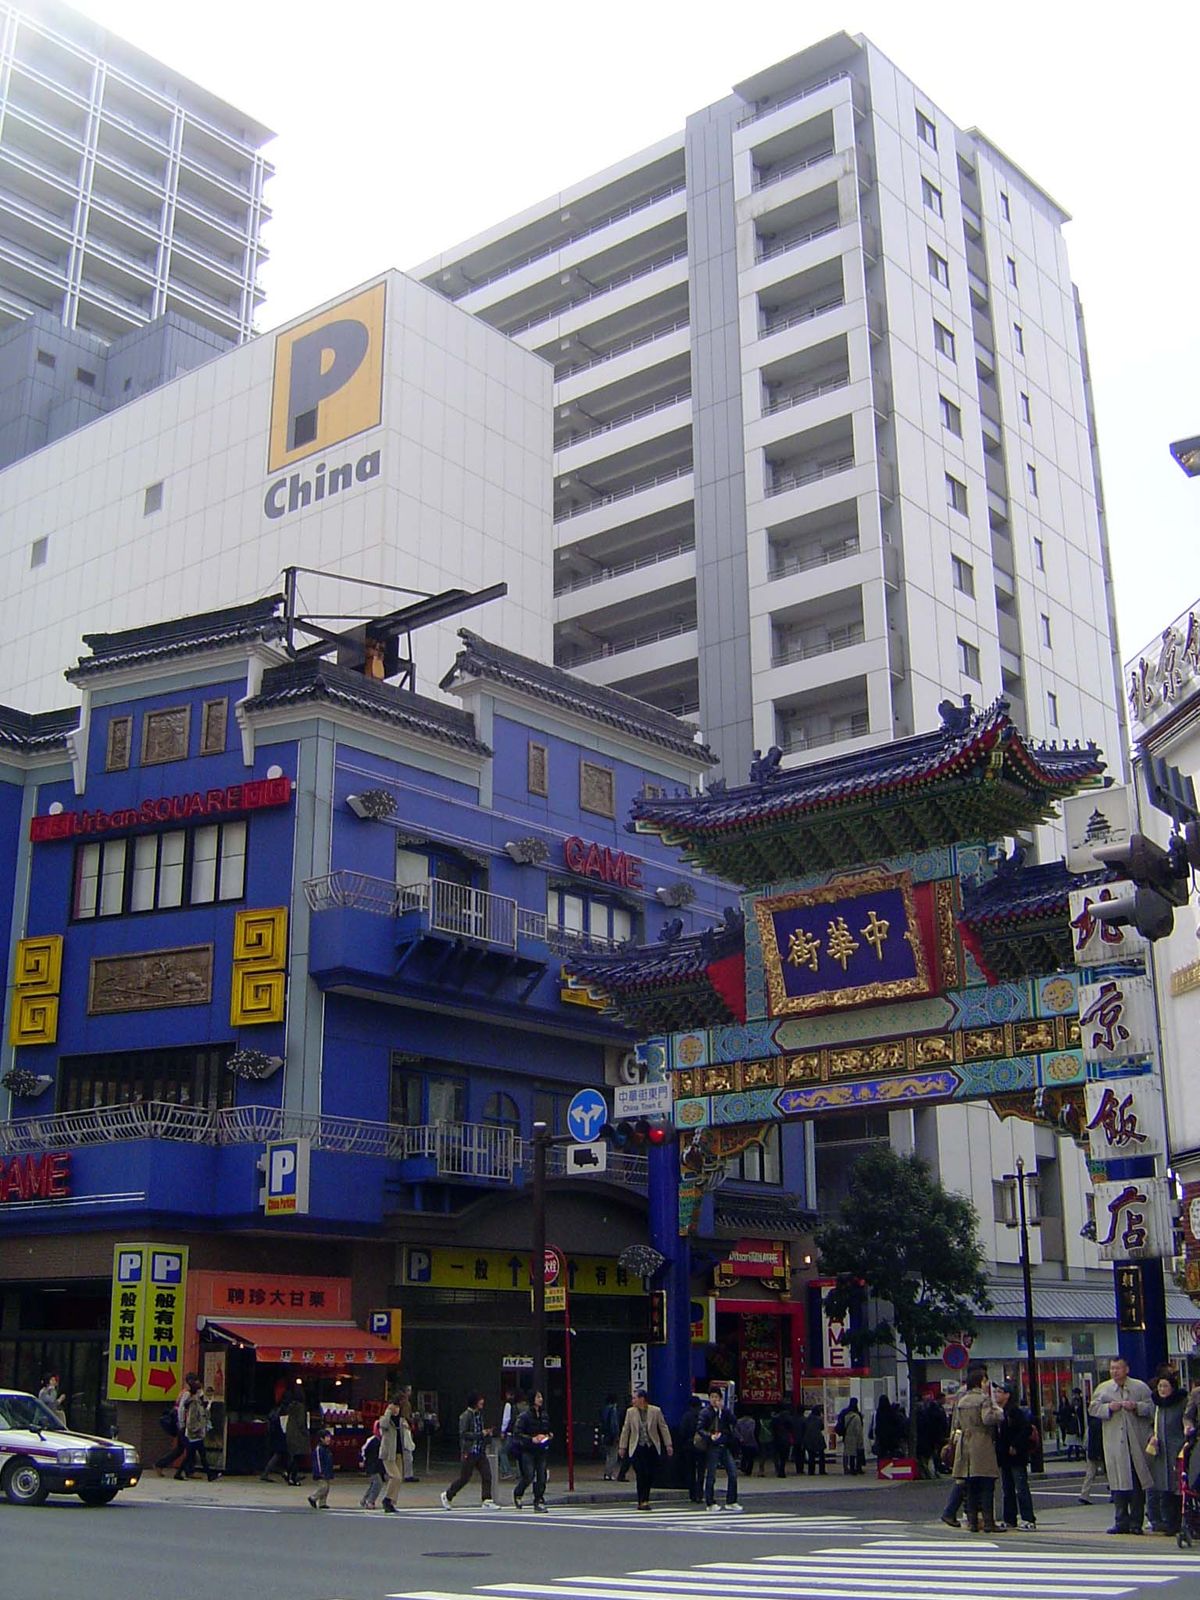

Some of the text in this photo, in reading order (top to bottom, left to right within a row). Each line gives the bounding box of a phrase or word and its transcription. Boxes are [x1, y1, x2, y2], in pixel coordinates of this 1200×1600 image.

[286, 319, 369, 453] P
[264, 450, 381, 519] China
[564, 836, 645, 890] GAME
[619, 1086, 668, 1103] 中華街東門
[623, 1104, 639, 1112] China
[0, 1151, 71, 1200] AME
[271, 1150, 295, 1192] P
[120, 1254, 141, 1279] P
[154, 1254, 180, 1280] P
[411, 1252, 429, 1280] P
[153, 1285, 176, 1342] 一般有料
[373, 1314, 388, 1331] P
[115, 1344, 137, 1361] IN
[149, 1345, 177, 1362] IN
